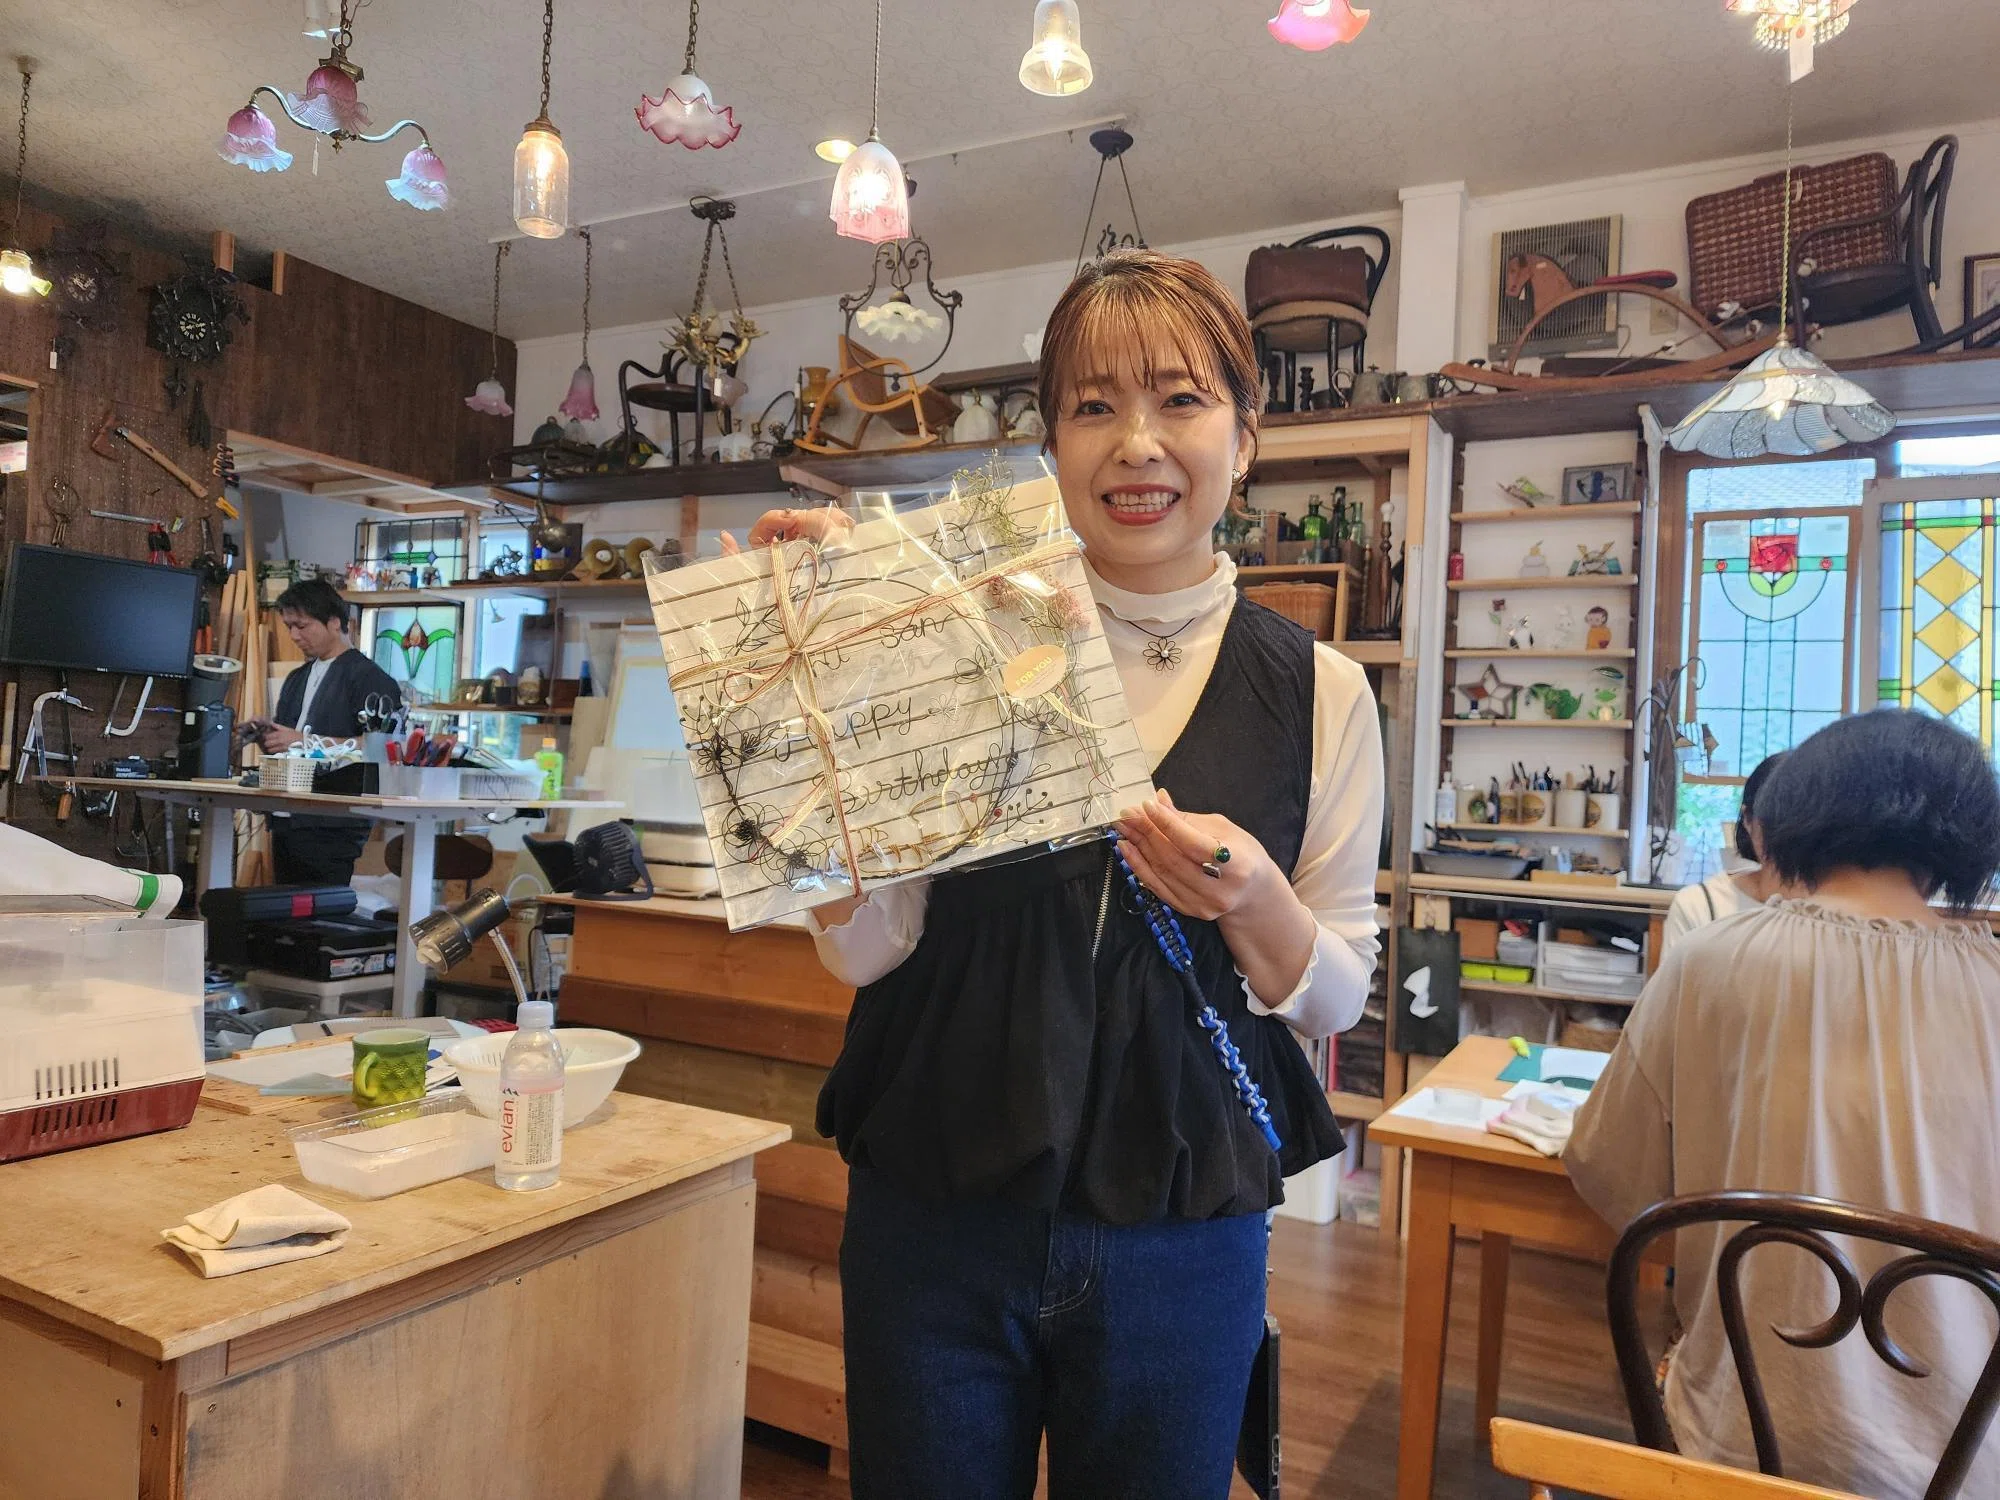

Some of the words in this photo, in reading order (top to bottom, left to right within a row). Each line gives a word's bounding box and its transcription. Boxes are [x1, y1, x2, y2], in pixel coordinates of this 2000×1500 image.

[1015, 670, 1034, 687] FOR
[1032, 655, 1053, 673] YOU
[502, 1099, 514, 1153] evian
